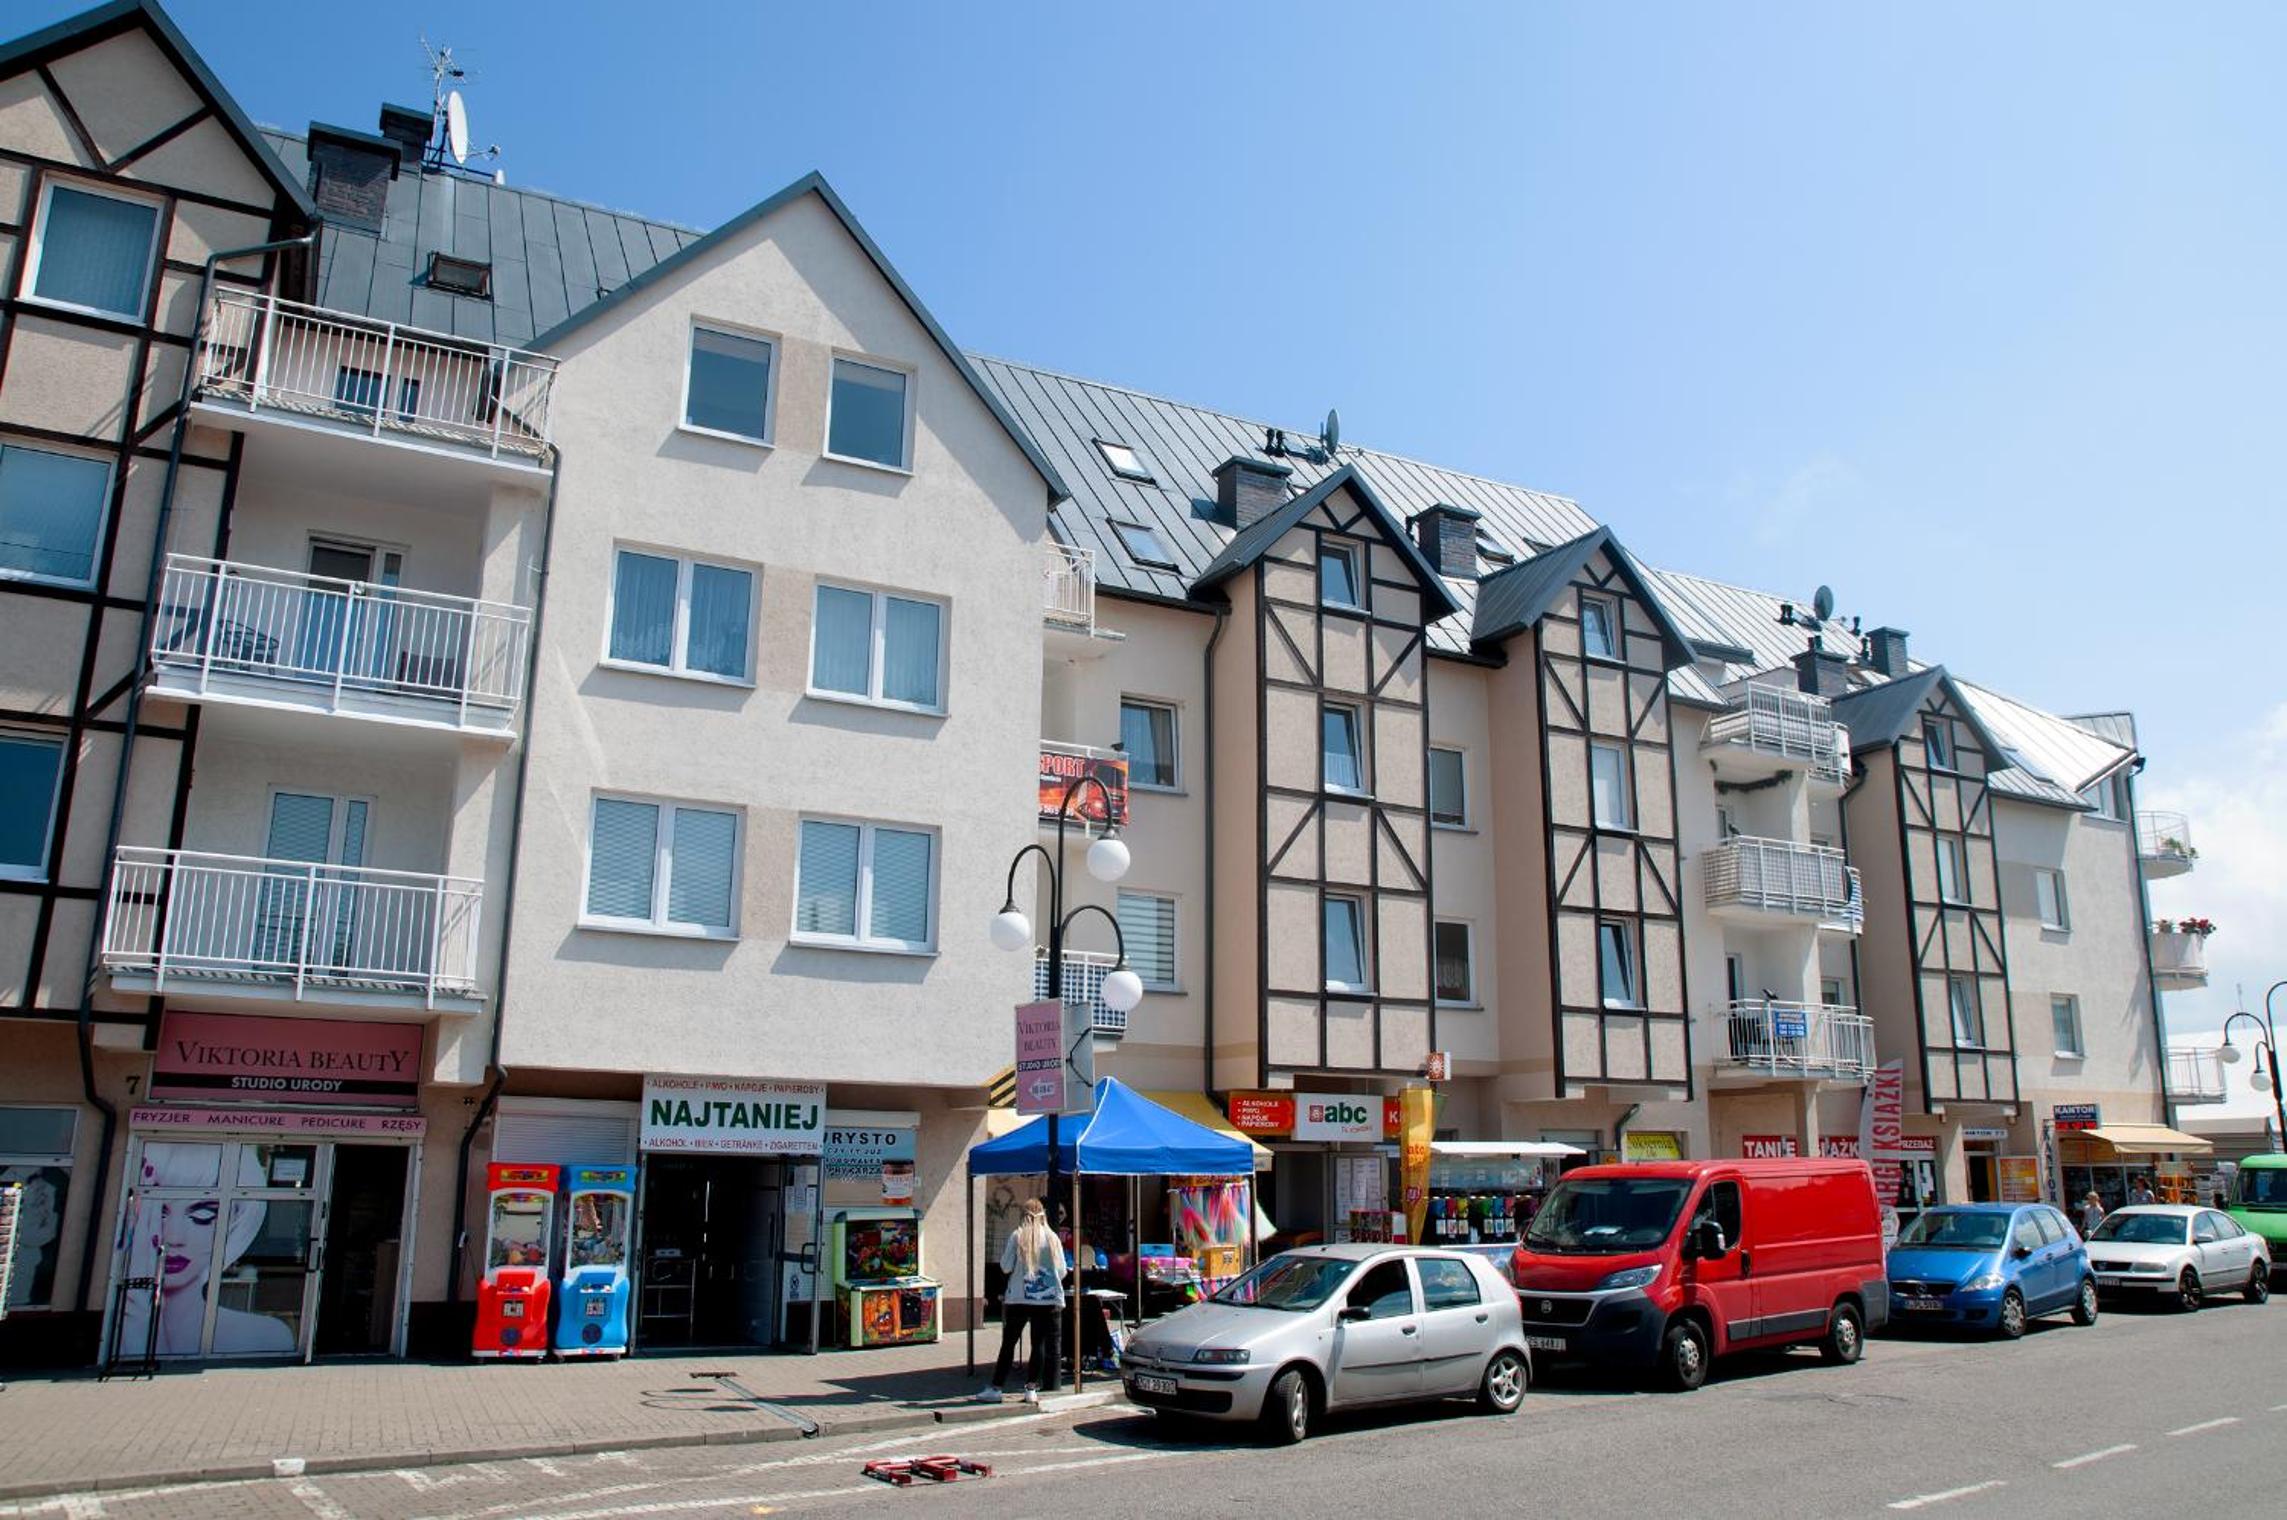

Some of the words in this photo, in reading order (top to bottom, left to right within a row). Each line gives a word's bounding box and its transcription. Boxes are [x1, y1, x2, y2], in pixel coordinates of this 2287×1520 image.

[311, 1050, 410, 1072] BEAUTY
[125, 1075, 141, 1096] 7
[231, 1076, 288, 1091] STUDIO
[291, 1077, 343, 1092] URODY
[133, 1111, 191, 1124] FRYZJER
[207, 1114, 286, 1126] MANICURE
[301, 1117, 367, 1129] PEDICURE
[650, 1099, 819, 1131] NAJTANIEJ
[1324, 1102, 1367, 1124] abc
[1743, 1141, 1796, 1158] TANIE
